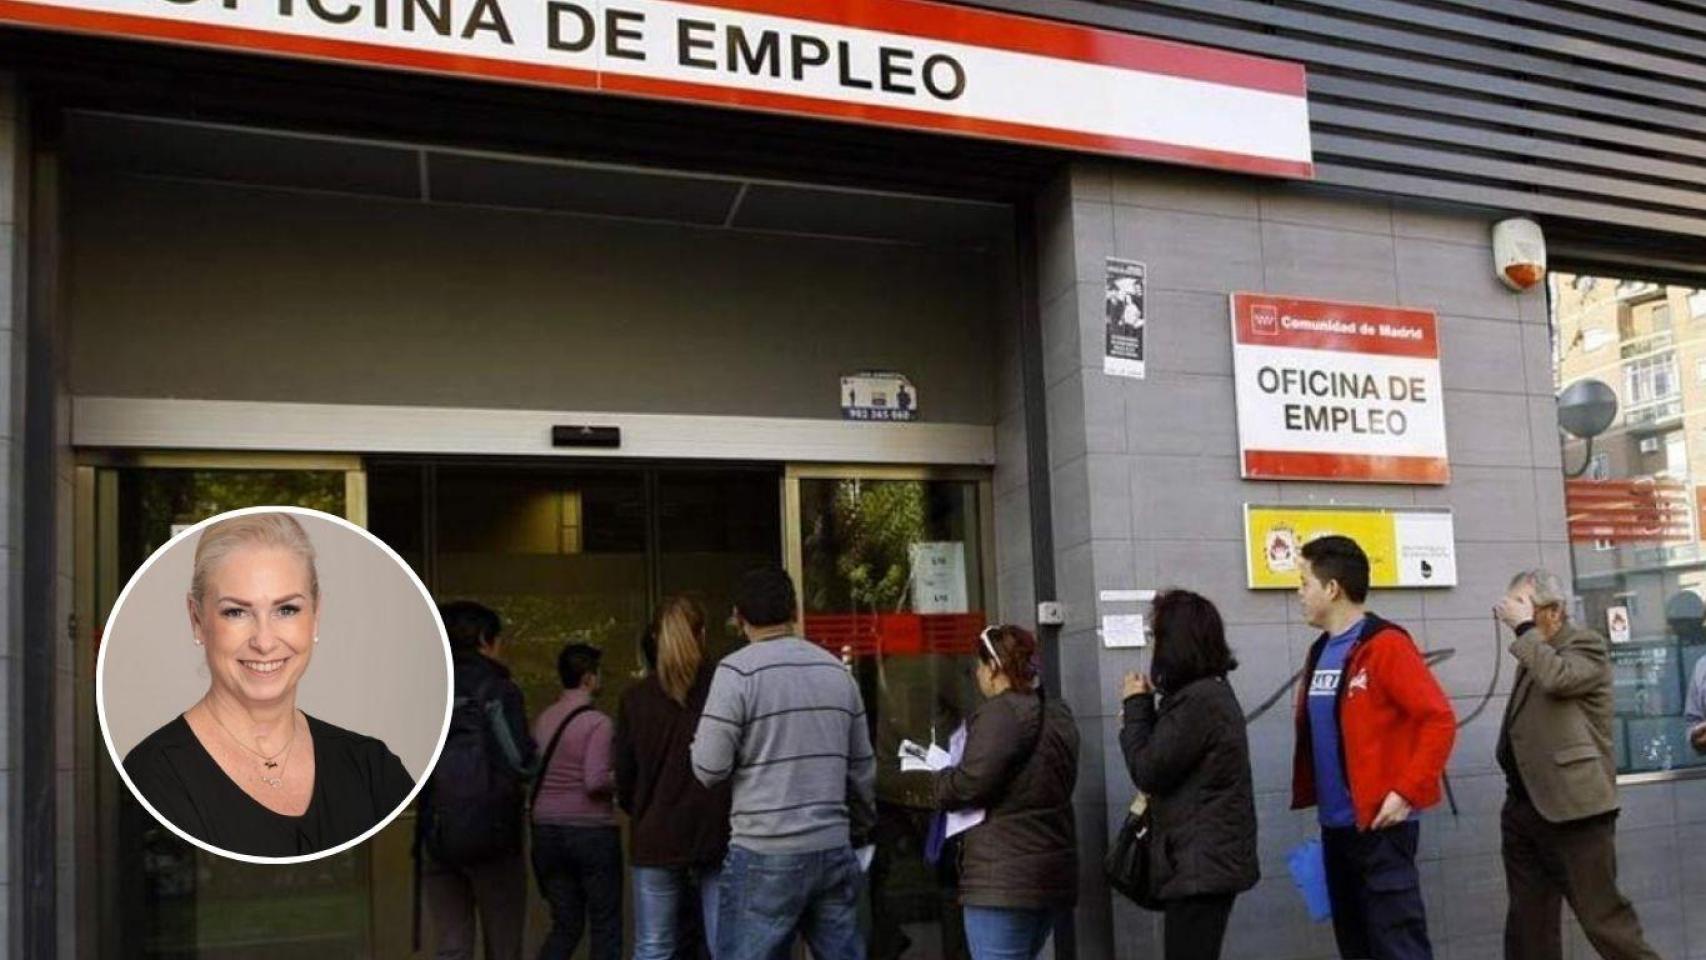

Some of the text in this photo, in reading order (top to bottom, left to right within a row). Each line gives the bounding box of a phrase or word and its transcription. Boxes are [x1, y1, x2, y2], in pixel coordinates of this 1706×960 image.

[547, 0, 646, 61] DE
[677, 18, 966, 101] EMPLEO
[1281, 315, 1424, 340] Comunidad de Madrid
[1257, 365, 1427, 403] OFICINA DE
[1284, 404, 1408, 435] EMPLEO
